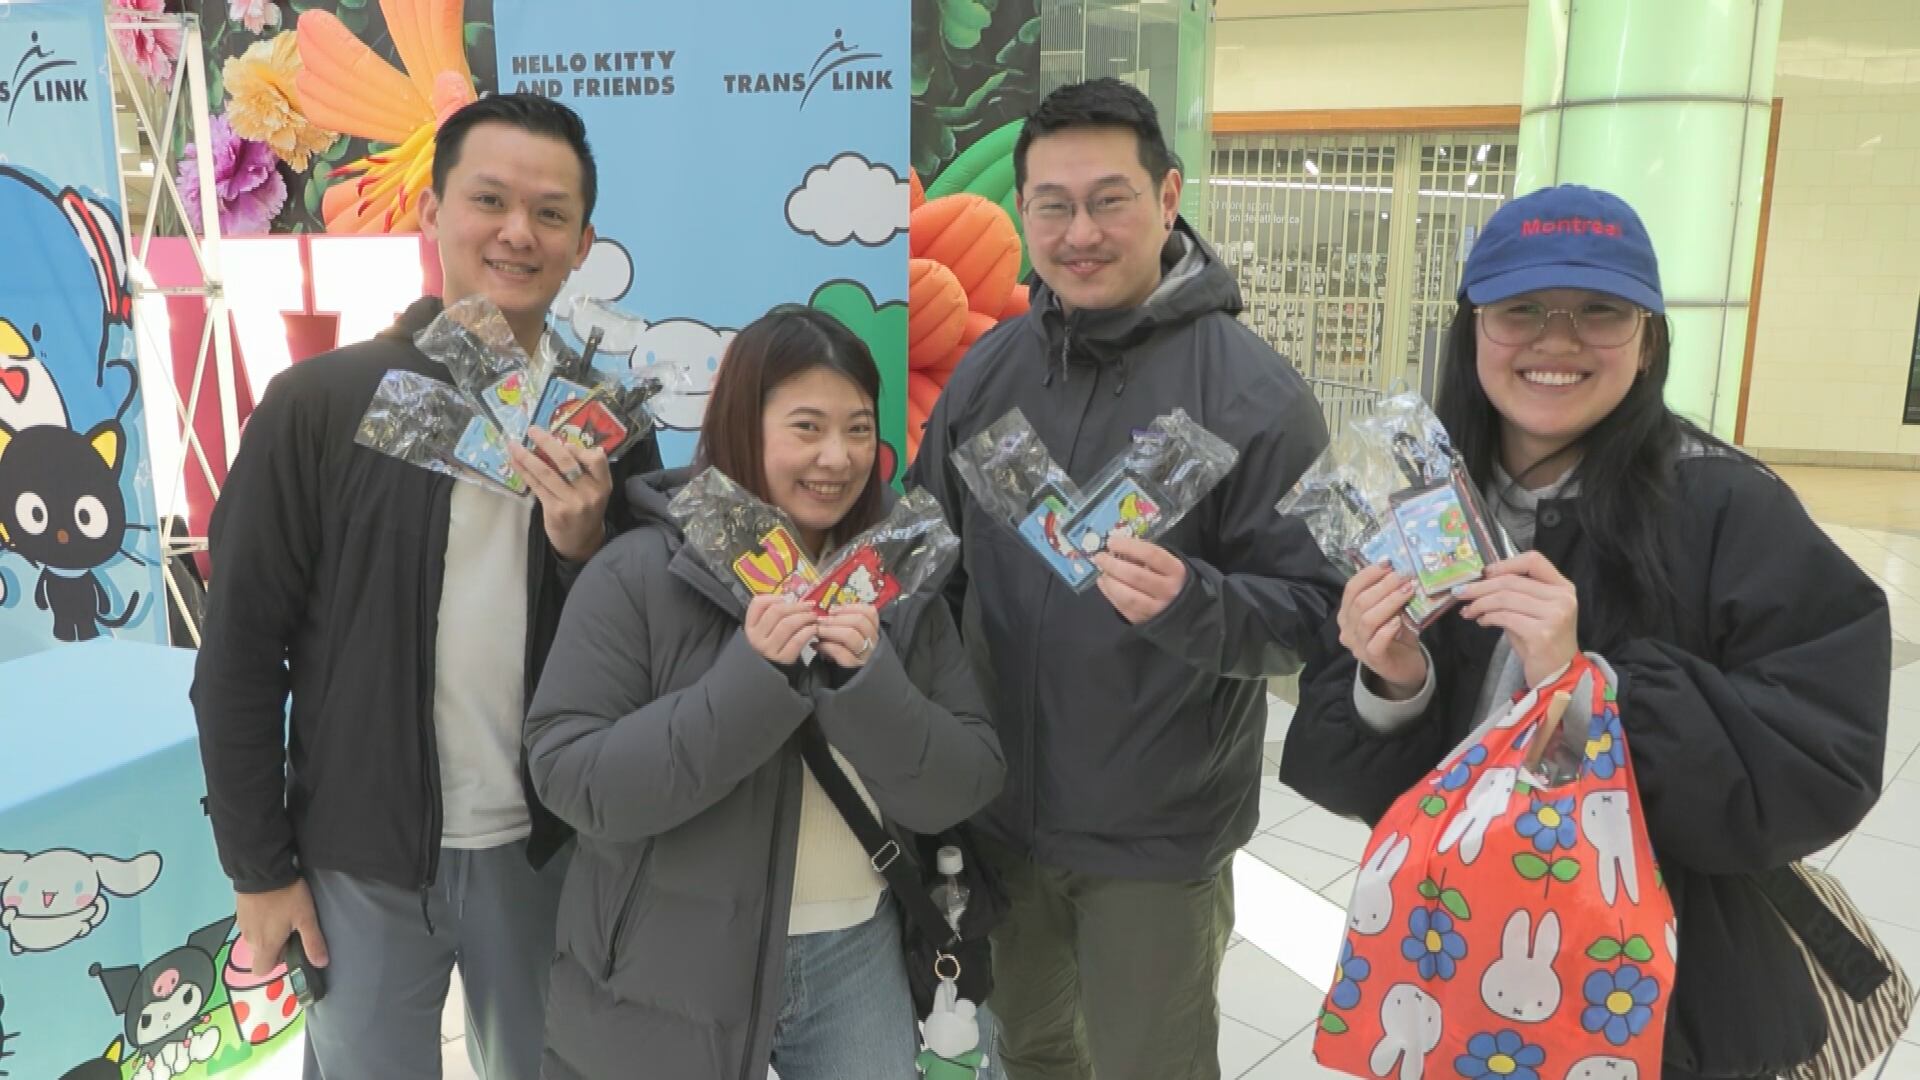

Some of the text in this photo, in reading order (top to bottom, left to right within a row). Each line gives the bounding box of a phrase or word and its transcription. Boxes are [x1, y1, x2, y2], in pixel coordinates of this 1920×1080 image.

[512, 50, 676, 74] HELLO KITTY
[33, 79, 89, 101] LINK
[516, 76, 675, 98] AND FRIENDS
[723, 70, 893, 94] TRANS LINK
